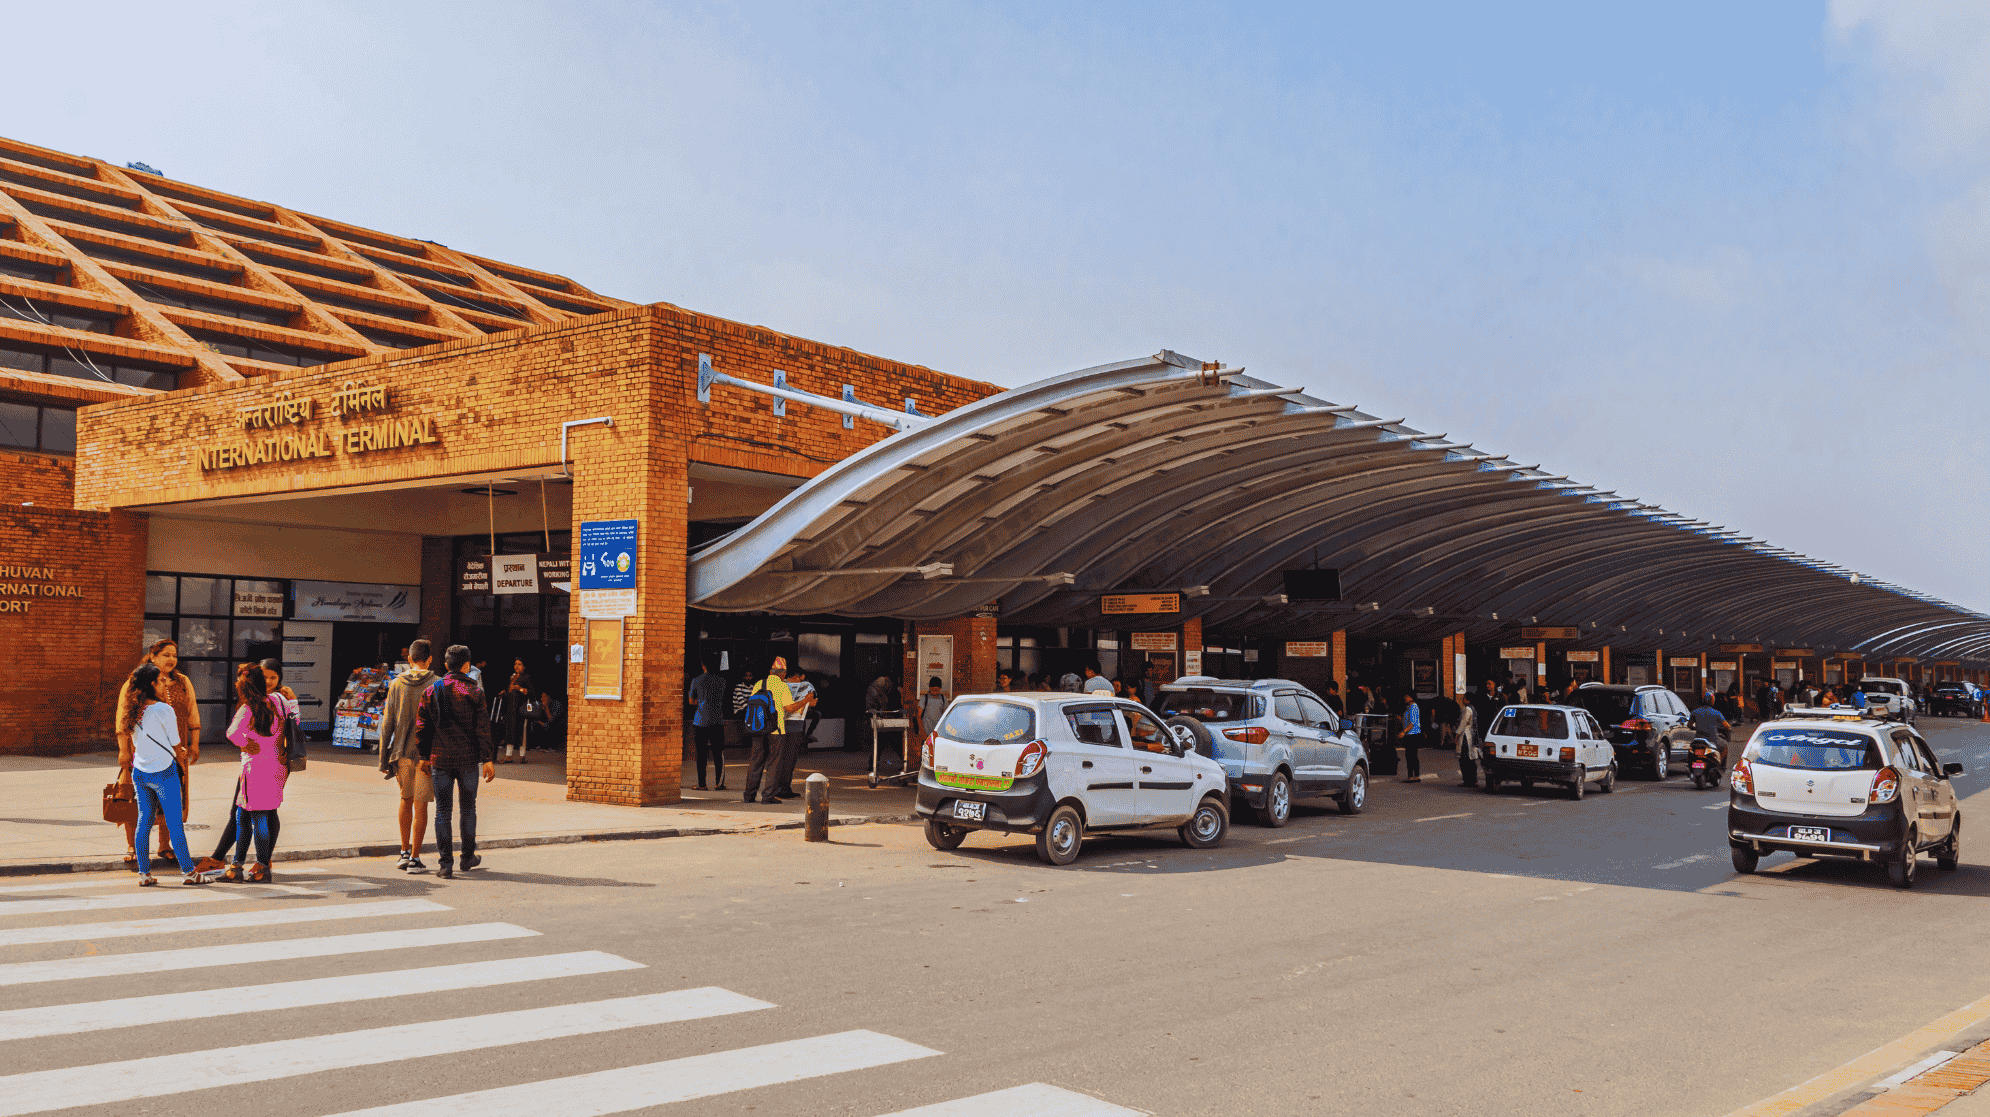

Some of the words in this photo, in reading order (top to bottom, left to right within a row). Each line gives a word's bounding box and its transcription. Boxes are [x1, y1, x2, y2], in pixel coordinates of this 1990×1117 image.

[196, 431, 330, 470] INTERNATIONAL
[336, 418, 436, 456] TERMINAL
[539, 560, 558, 568] NEPALI
[497, 579, 533, 588] DEPARTURE
[1003, 728, 1024, 740] TAXI
